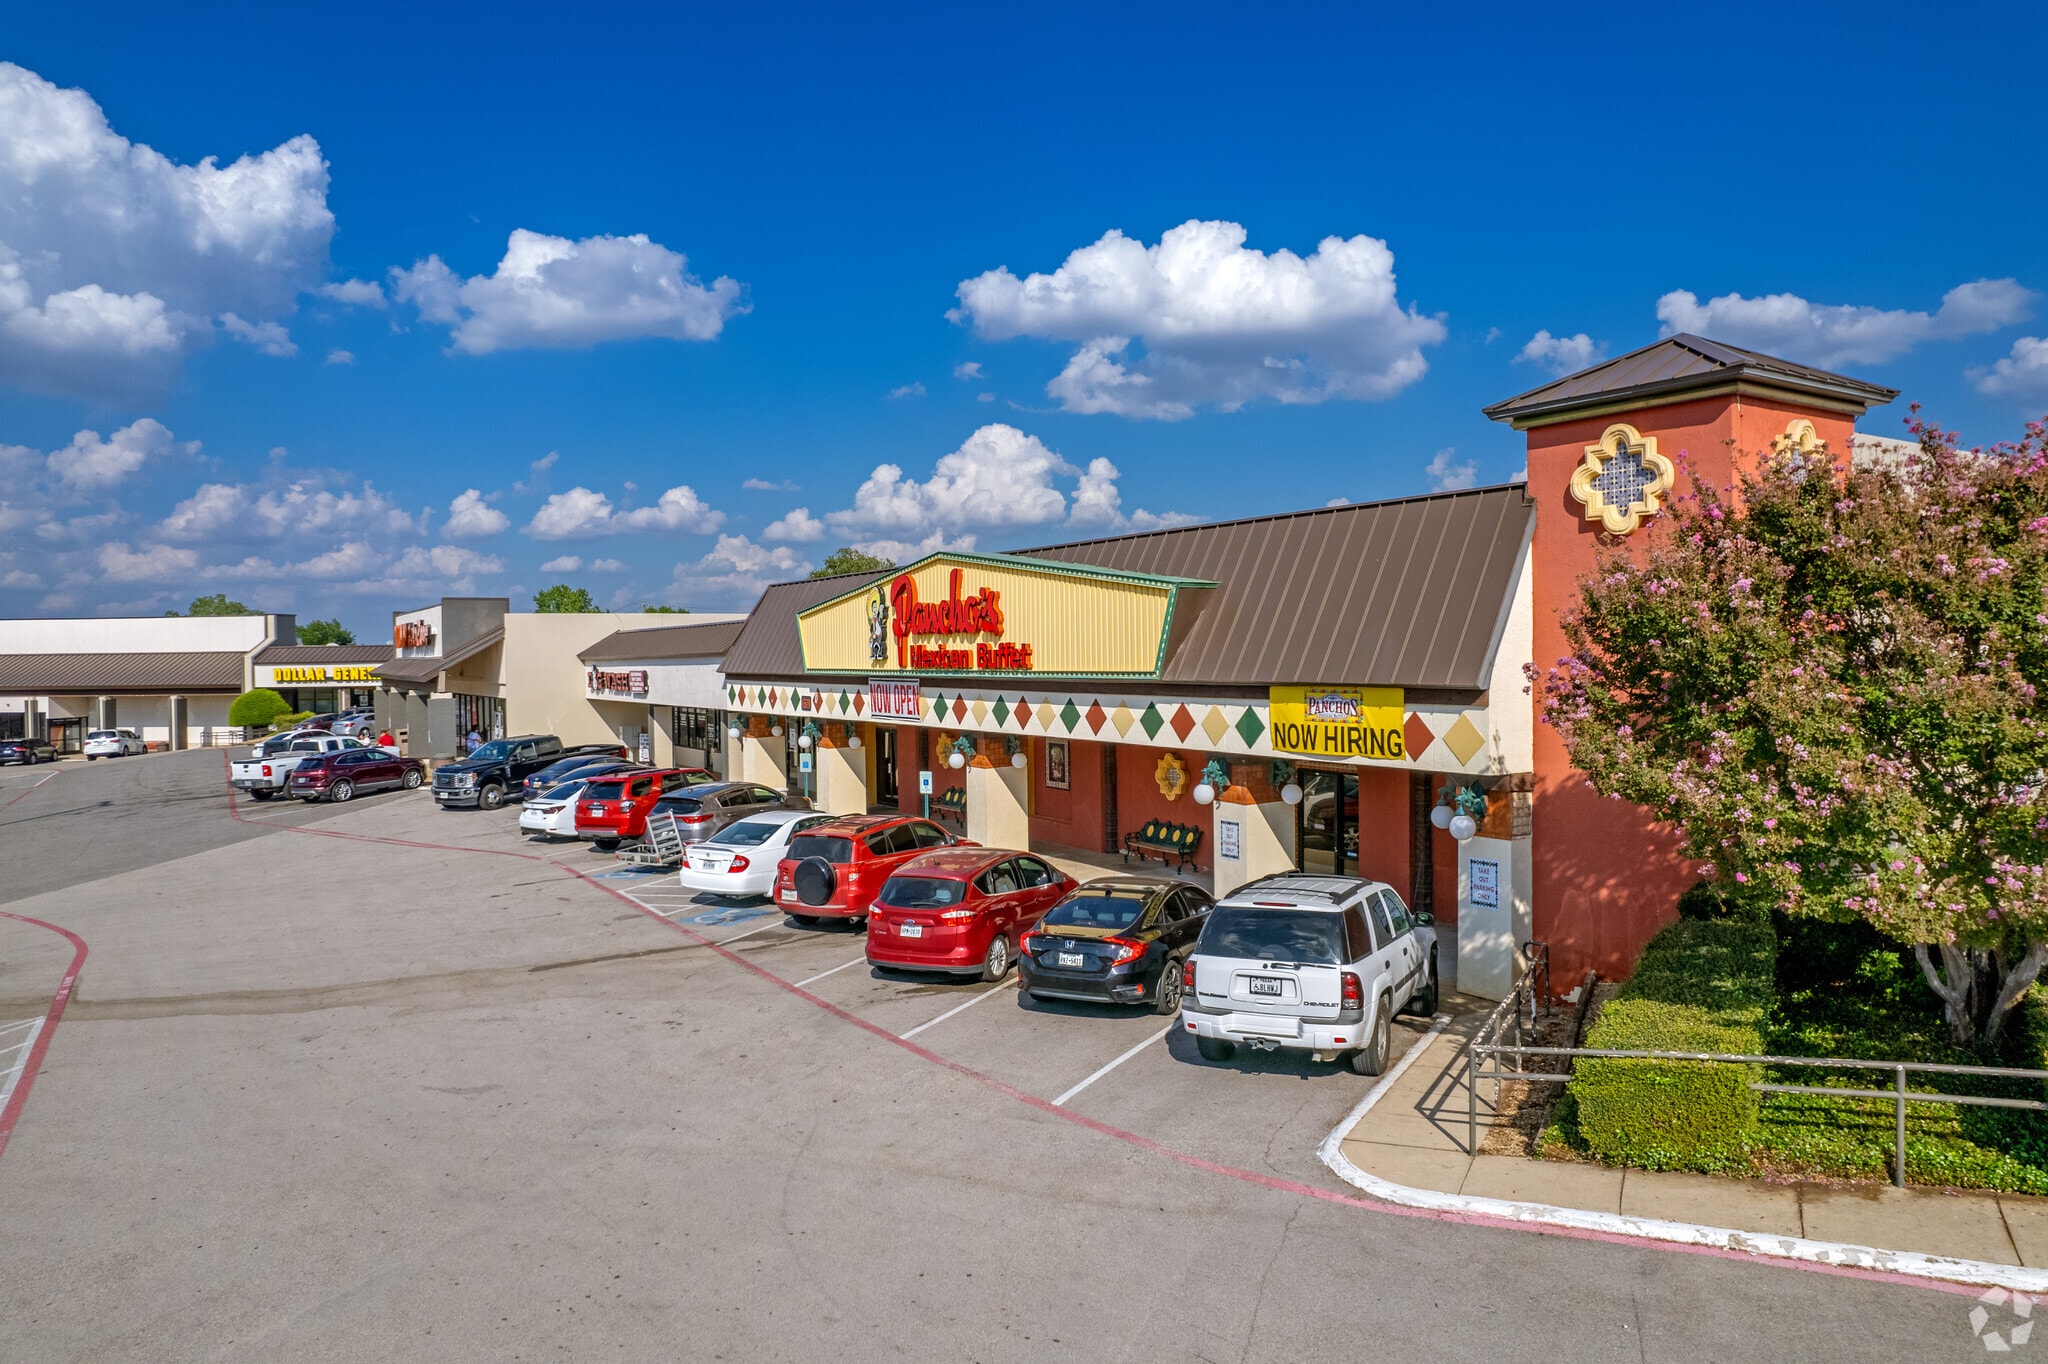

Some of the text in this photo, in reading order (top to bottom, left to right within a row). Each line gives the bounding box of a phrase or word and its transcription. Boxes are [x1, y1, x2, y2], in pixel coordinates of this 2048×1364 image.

[890, 568, 1004, 667] Pancho's
[910, 642, 1033, 669] Mexican Buffet
[274, 667, 382, 682] DOLLAR GENE
[869, 683, 920, 716] NOW OPEN
[1273, 722, 1402, 757] NOW HIRING
[1473, 883, 1495, 892] PARKING
[1477, 892, 1491, 900] ONLY
